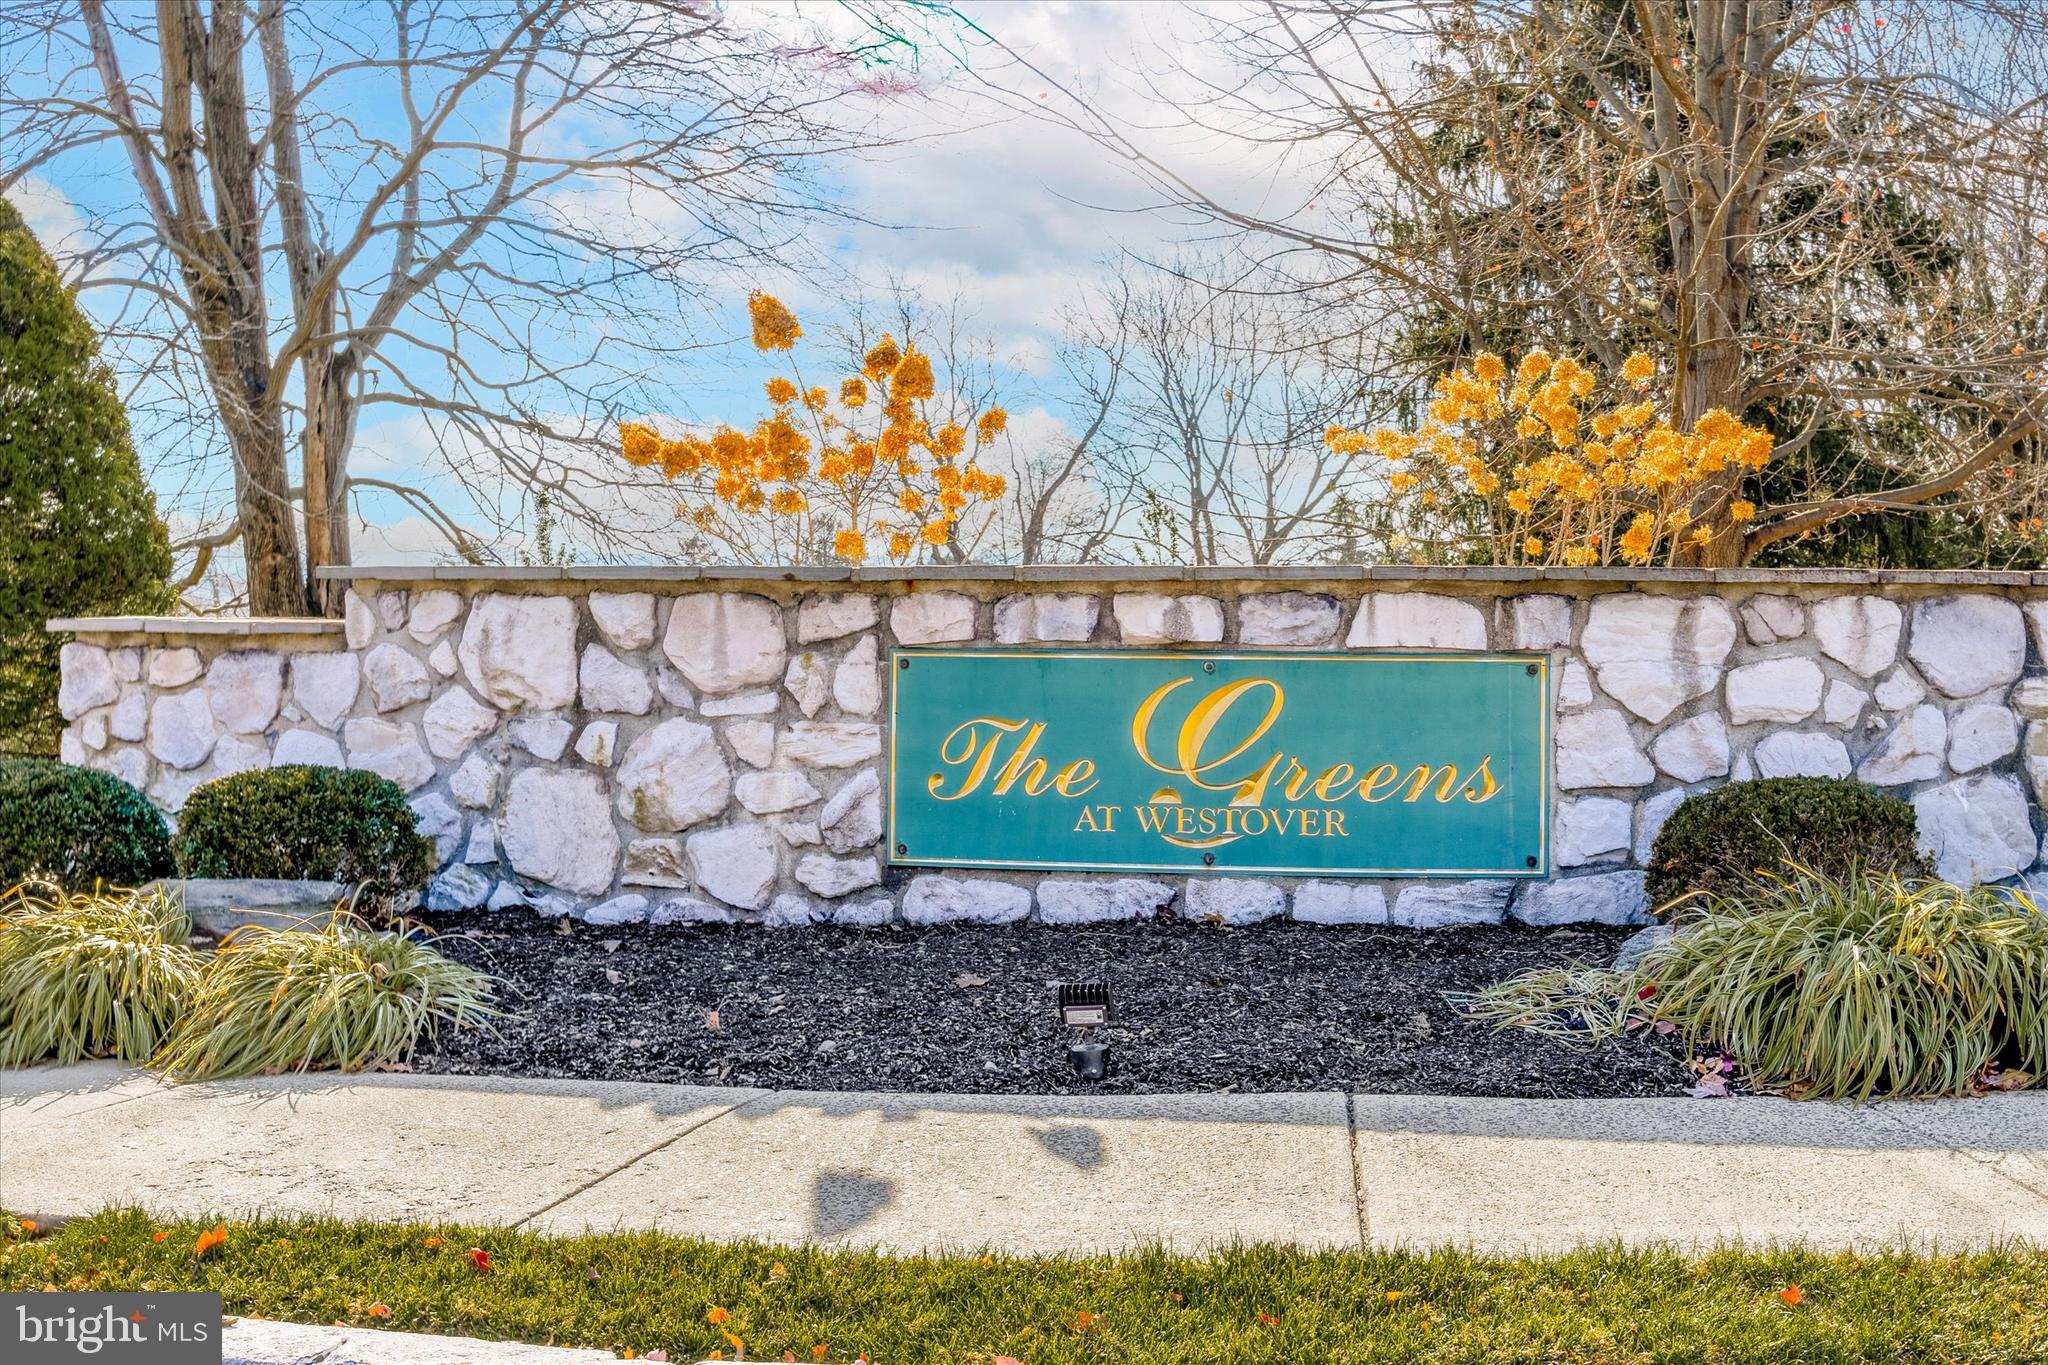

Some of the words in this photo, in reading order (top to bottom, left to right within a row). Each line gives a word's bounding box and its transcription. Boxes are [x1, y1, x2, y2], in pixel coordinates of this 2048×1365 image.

[927, 716, 1100, 801] The
[1131, 675, 1505, 849] Greens
[1073, 804, 1121, 833] AT
[1134, 804, 1350, 838] WESTOVER
